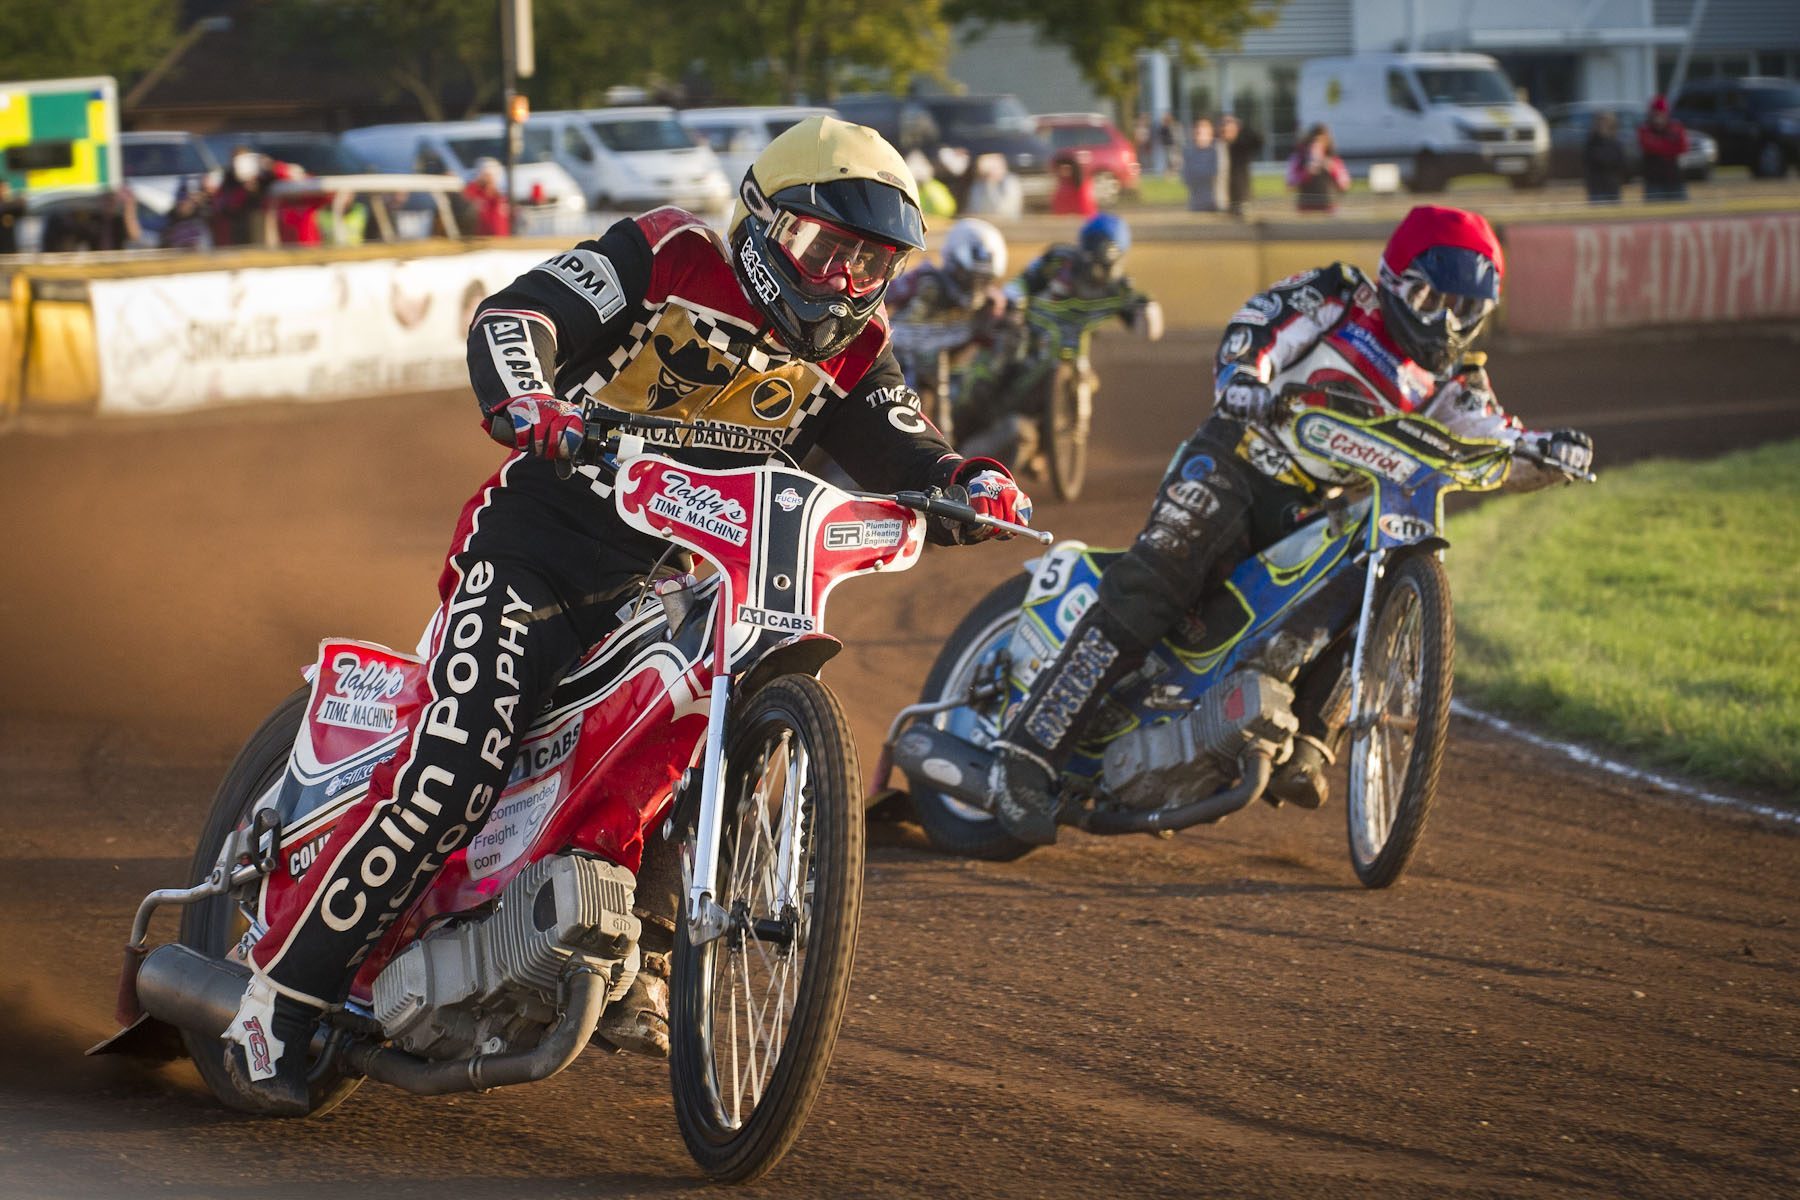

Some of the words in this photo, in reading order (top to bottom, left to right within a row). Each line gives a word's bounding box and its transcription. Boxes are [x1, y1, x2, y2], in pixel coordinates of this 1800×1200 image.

[1571, 215, 1800, 331] READYPO
[755, 380, 792, 411] 7
[693, 420, 783, 451] BANDITS
[1330, 433, 1401, 472] Castrol
[666, 474, 742, 520] Taffy's
[777, 495, 802, 504] FUCHS
[654, 497, 684, 519] TIME
[684, 510, 742, 543] MACHINE
[828, 526, 861, 545] SR
[865, 522, 900, 530] Plumbing
[864, 537, 897, 545] Engineer
[1040, 558, 1064, 591] 5
[739, 608, 763, 624] A1
[767, 613, 814, 631] CABS
[338, 657, 401, 701] Taffy's
[323, 699, 351, 722] TIME
[351, 704, 394, 729] MACHINE
[320, 763, 456, 932] Colin
[426, 560, 495, 745] Poole
[534, 722, 581, 770] CABS
[487, 779, 556, 824] commended
[474, 853, 501, 870] com
